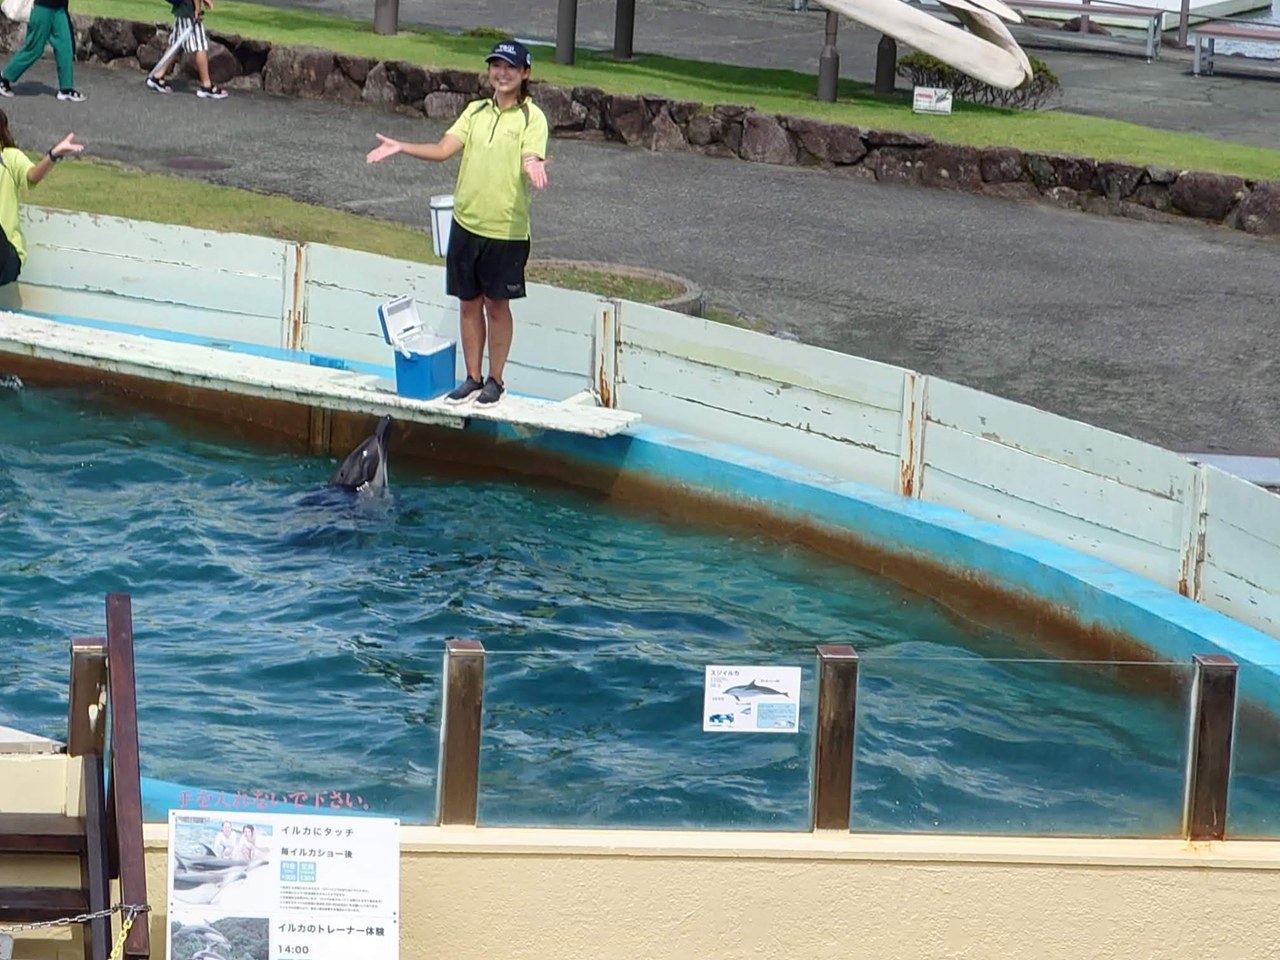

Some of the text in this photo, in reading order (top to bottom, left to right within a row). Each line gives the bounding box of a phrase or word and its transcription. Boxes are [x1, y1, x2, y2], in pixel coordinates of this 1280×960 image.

[281, 826, 354, 837] イルカにタッチ
[281, 847, 353, 858] 毎イルカショー後
[278, 923, 385, 936] イルカのトレーナー体験
[278, 944, 309, 954] 14:00
